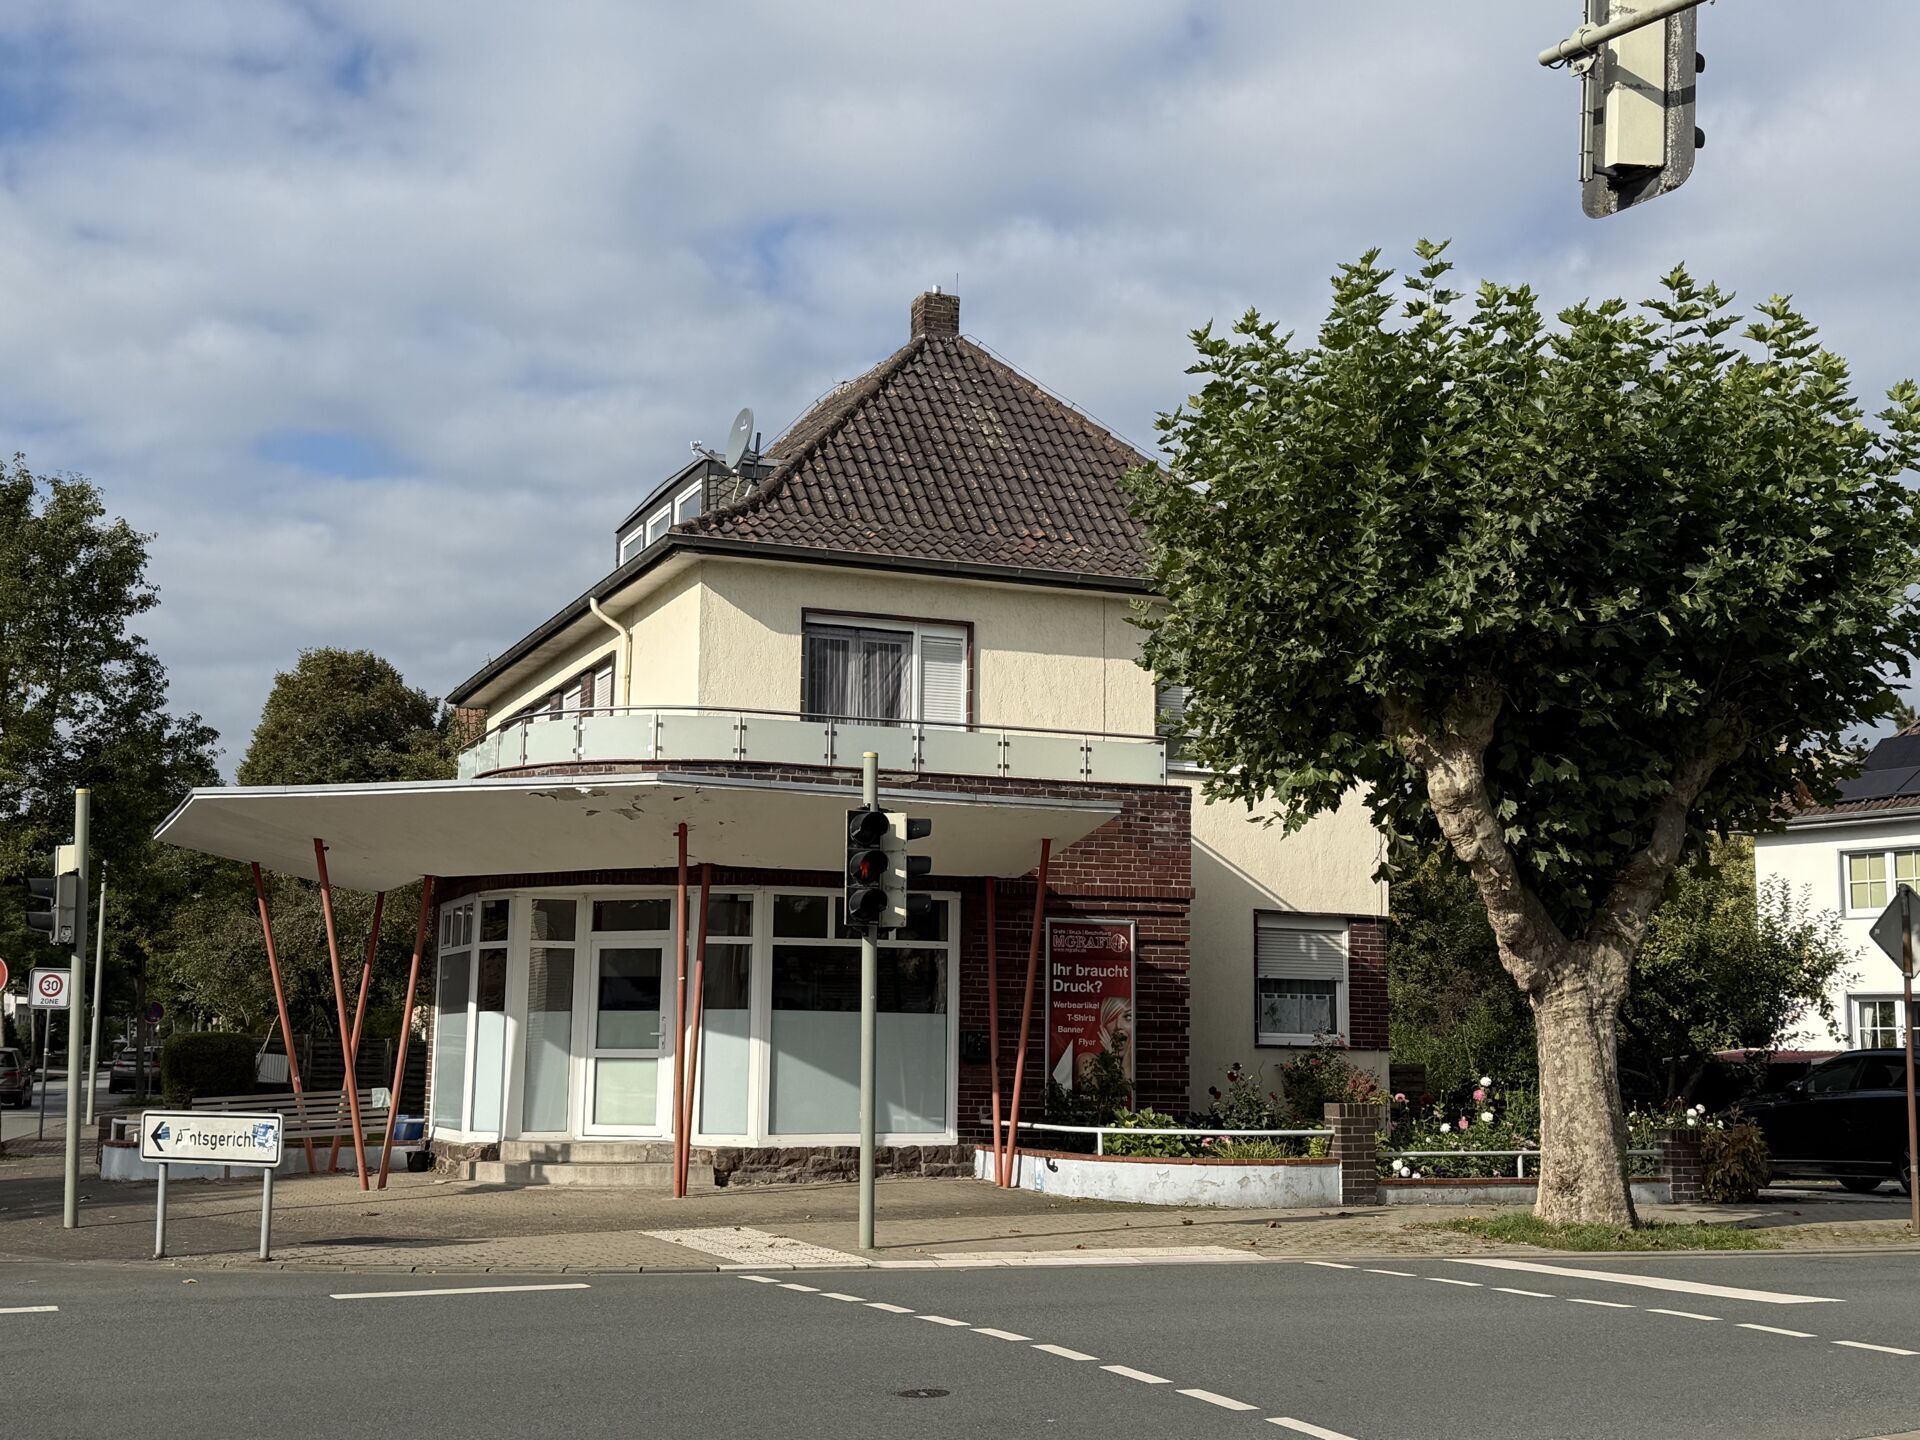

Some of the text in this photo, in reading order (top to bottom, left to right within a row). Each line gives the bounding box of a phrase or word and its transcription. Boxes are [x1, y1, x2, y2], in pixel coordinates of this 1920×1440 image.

[1053, 963, 1128, 978] Ihr braucht
[44, 980, 58, 991] 30
[1053, 979, 1103, 993] Druck?
[1053, 1001, 1100, 1009] Werbeartikel
[1067, 1014, 1096, 1022] T-Shirts
[1078, 1039, 1096, 1047] Flyer
